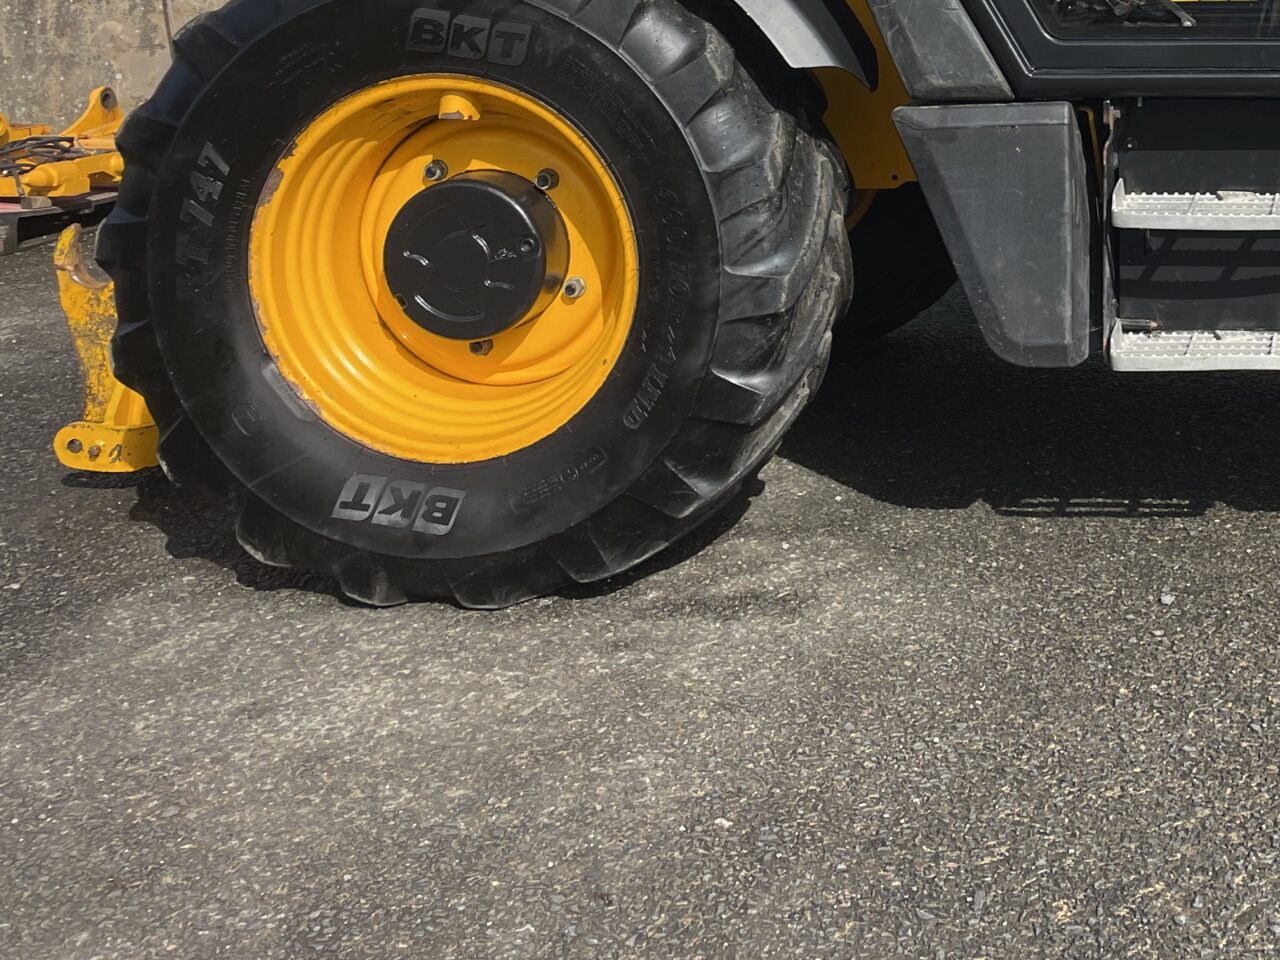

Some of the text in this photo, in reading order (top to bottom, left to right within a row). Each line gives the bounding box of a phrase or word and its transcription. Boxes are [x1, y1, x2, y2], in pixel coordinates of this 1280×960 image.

[410, 16, 528, 59] BKT
[178, 141, 231, 228] 747
[336, 478, 463, 531] BKT
